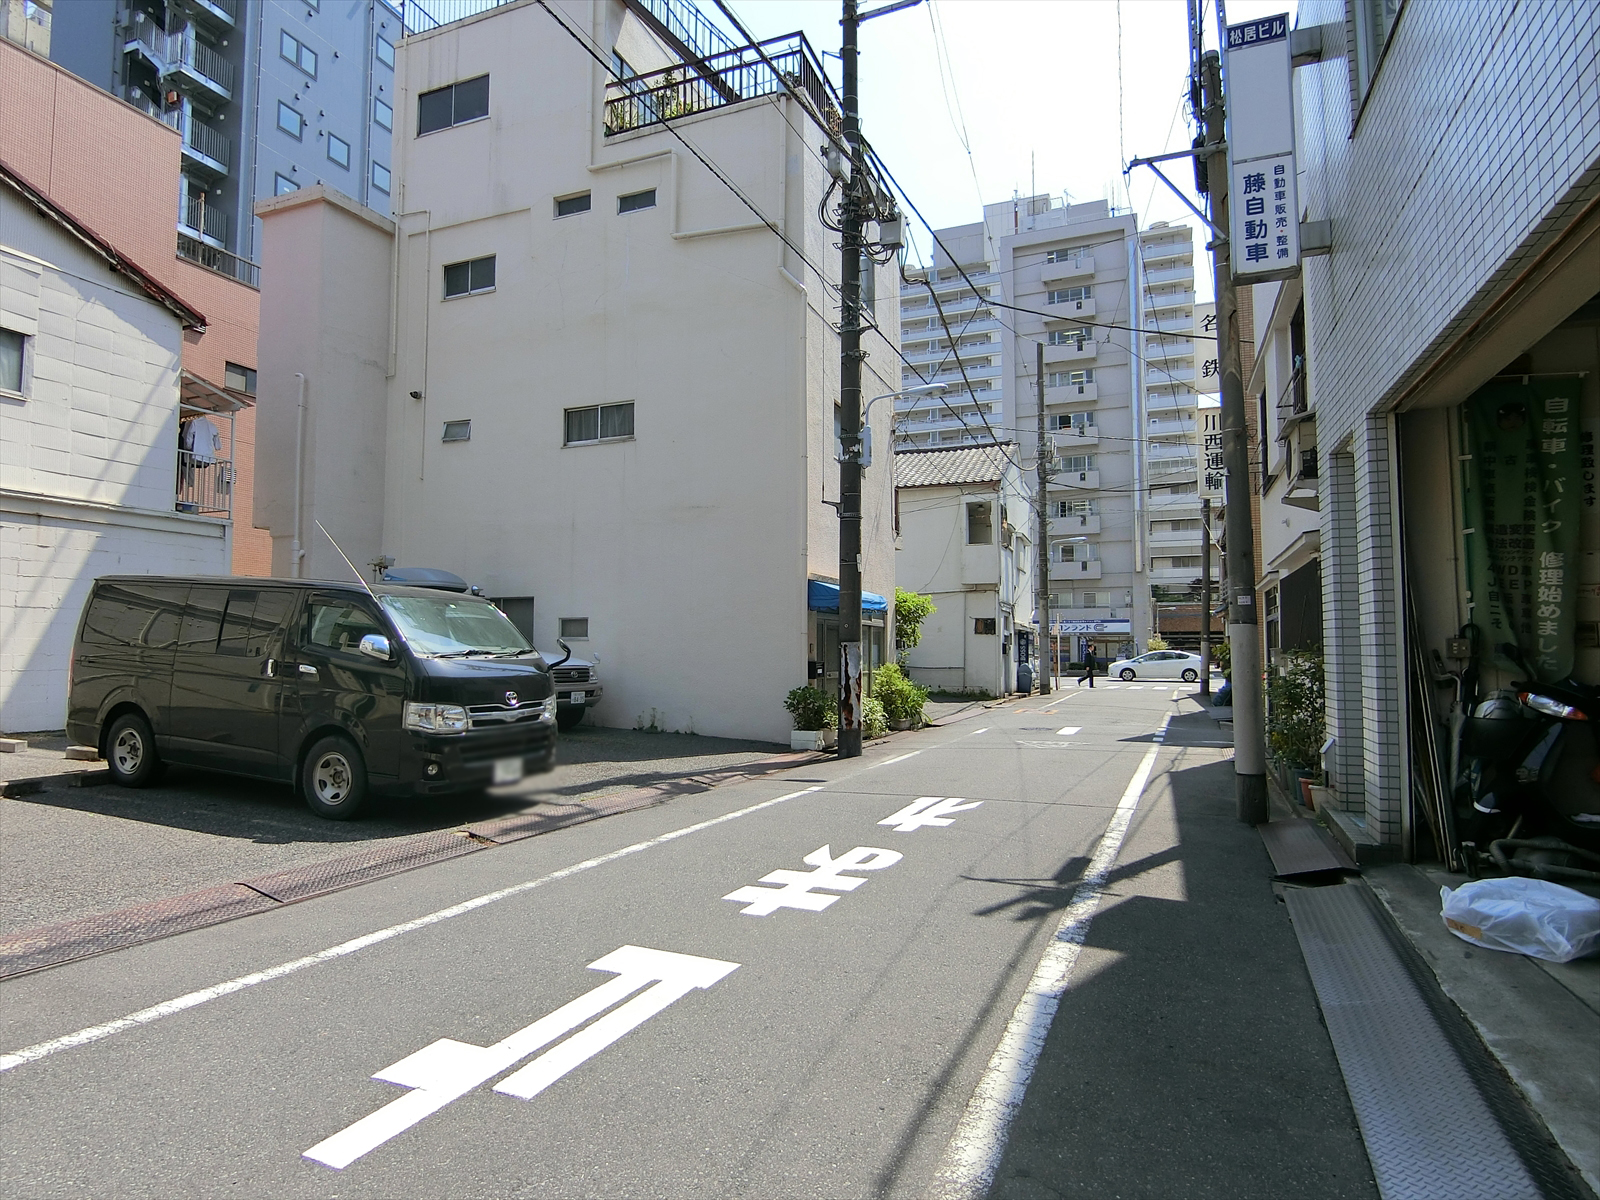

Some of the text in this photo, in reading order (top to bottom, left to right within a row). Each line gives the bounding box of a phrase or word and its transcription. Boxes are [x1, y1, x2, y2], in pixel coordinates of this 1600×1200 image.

[1230, 20, 1284, 45] 松居ビル
[1243, 172, 1269, 263] 藤自動車
[1273, 163, 1289, 260] 自動車販売・整備
[1200, 314, 1219, 378] 名鉄
[1204, 414, 1224, 491] 川西運輸
[1537, 397, 1569, 671] 自転車・バイク 修理始めました
